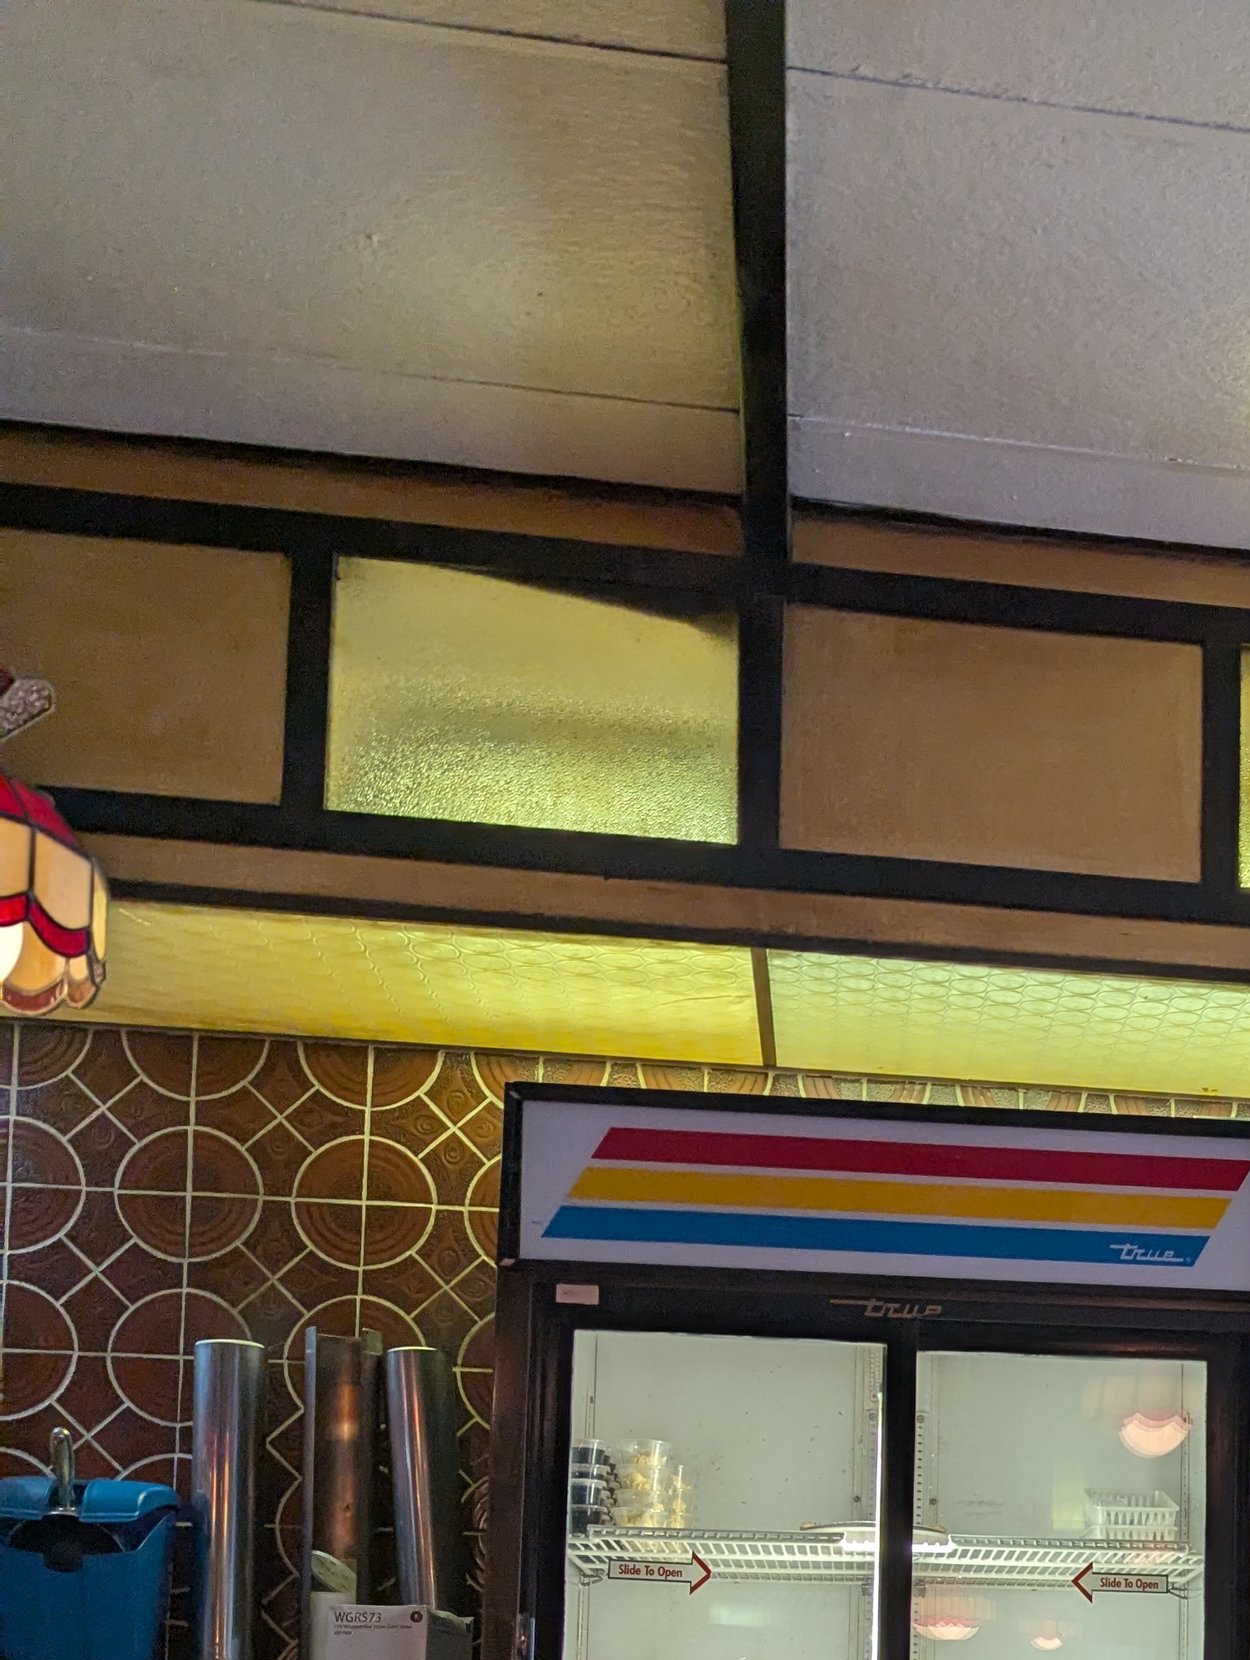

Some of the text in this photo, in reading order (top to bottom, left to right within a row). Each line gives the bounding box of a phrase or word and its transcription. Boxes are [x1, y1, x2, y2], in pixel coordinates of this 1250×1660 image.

[618, 1563, 683, 1580] Slide To Open
[1100, 1576, 1159, 1591] Slide To Open
